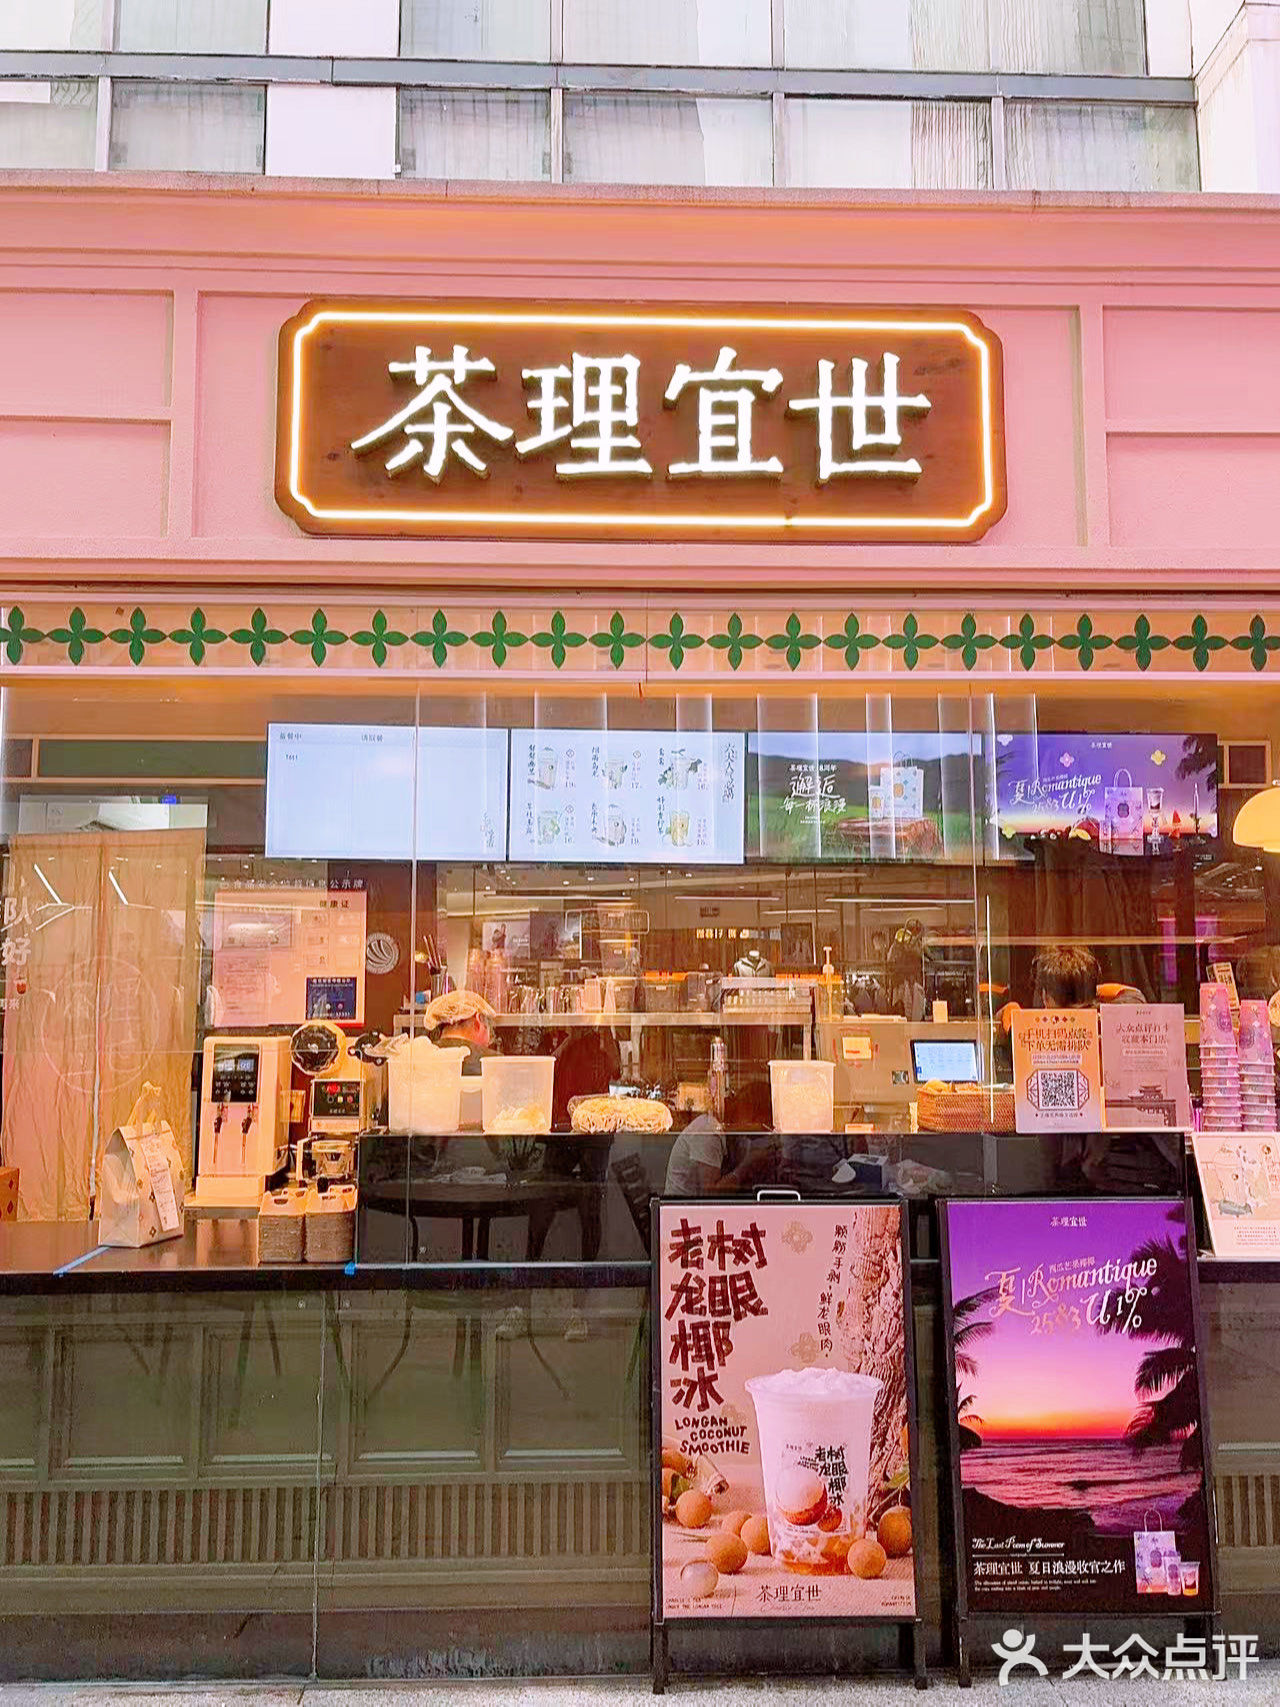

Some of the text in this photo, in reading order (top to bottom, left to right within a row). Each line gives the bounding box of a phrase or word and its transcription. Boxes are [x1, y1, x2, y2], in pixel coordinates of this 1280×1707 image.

[350, 345, 932, 483] 茶理宜世
[789, 772, 841, 799] 邂逅
[1008, 774, 1102, 805] 夏 Romantique
[319, 900, 350, 909] 健康证
[668, 1218, 768, 1271] 老树
[664, 1271, 769, 1322] 龙眼
[984, 1257, 1158, 1318] 夏 Romantique
[668, 1319, 734, 1371] 椰
[669, 1366, 725, 1412] 冰
[675, 1415, 728, 1431] LONGAN
[689, 1426, 747, 1442] COCONUT
[679, 1440, 751, 1455] SMOOTHIE
[815, 1445, 845, 1462] 老树
[818, 1460, 849, 1477] 龙眼
[828, 1477, 847, 1494] 椰
[972, 1537, 986, 1549] The
[1004, 1535, 1026, 1549] Poem
[1026, 1538, 1036, 1552] of
[1033, 1537, 1066, 1549] Summer
[973, 1559, 1126, 1576] 茶理宜世 夏日浪漫收官之作
[755, 1584, 823, 1603] 茶理宜世
